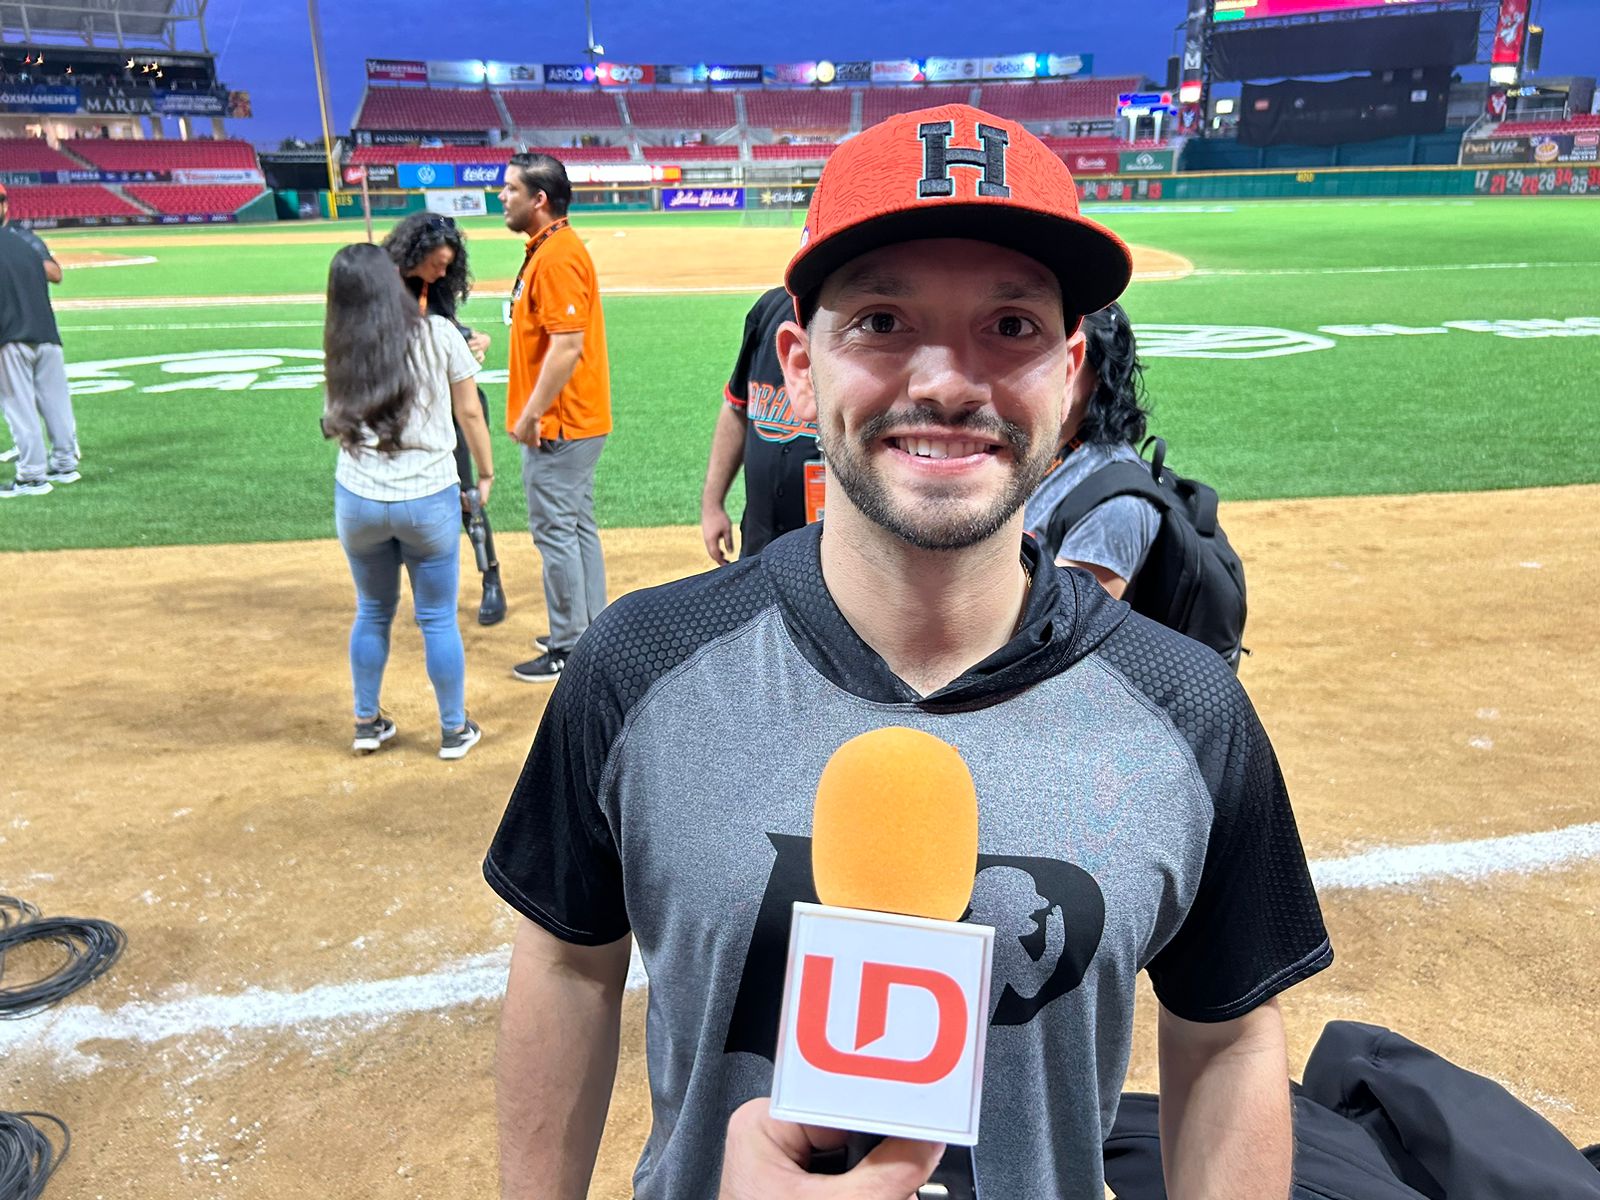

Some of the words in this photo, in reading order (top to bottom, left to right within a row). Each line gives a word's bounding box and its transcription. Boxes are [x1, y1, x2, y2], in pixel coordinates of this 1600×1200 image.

[548, 67, 583, 81] ARCO
[0, 91, 77, 105] ÓXIMAMENTE
[109, 87, 125, 98] LA
[86, 98, 152, 113] MAREA
[917, 120, 1010, 199] H
[463, 167, 500, 182] telcel
[1474, 170, 1490, 188] 17
[1506, 170, 1523, 189] 24
[1538, 172, 1556, 190] 28
